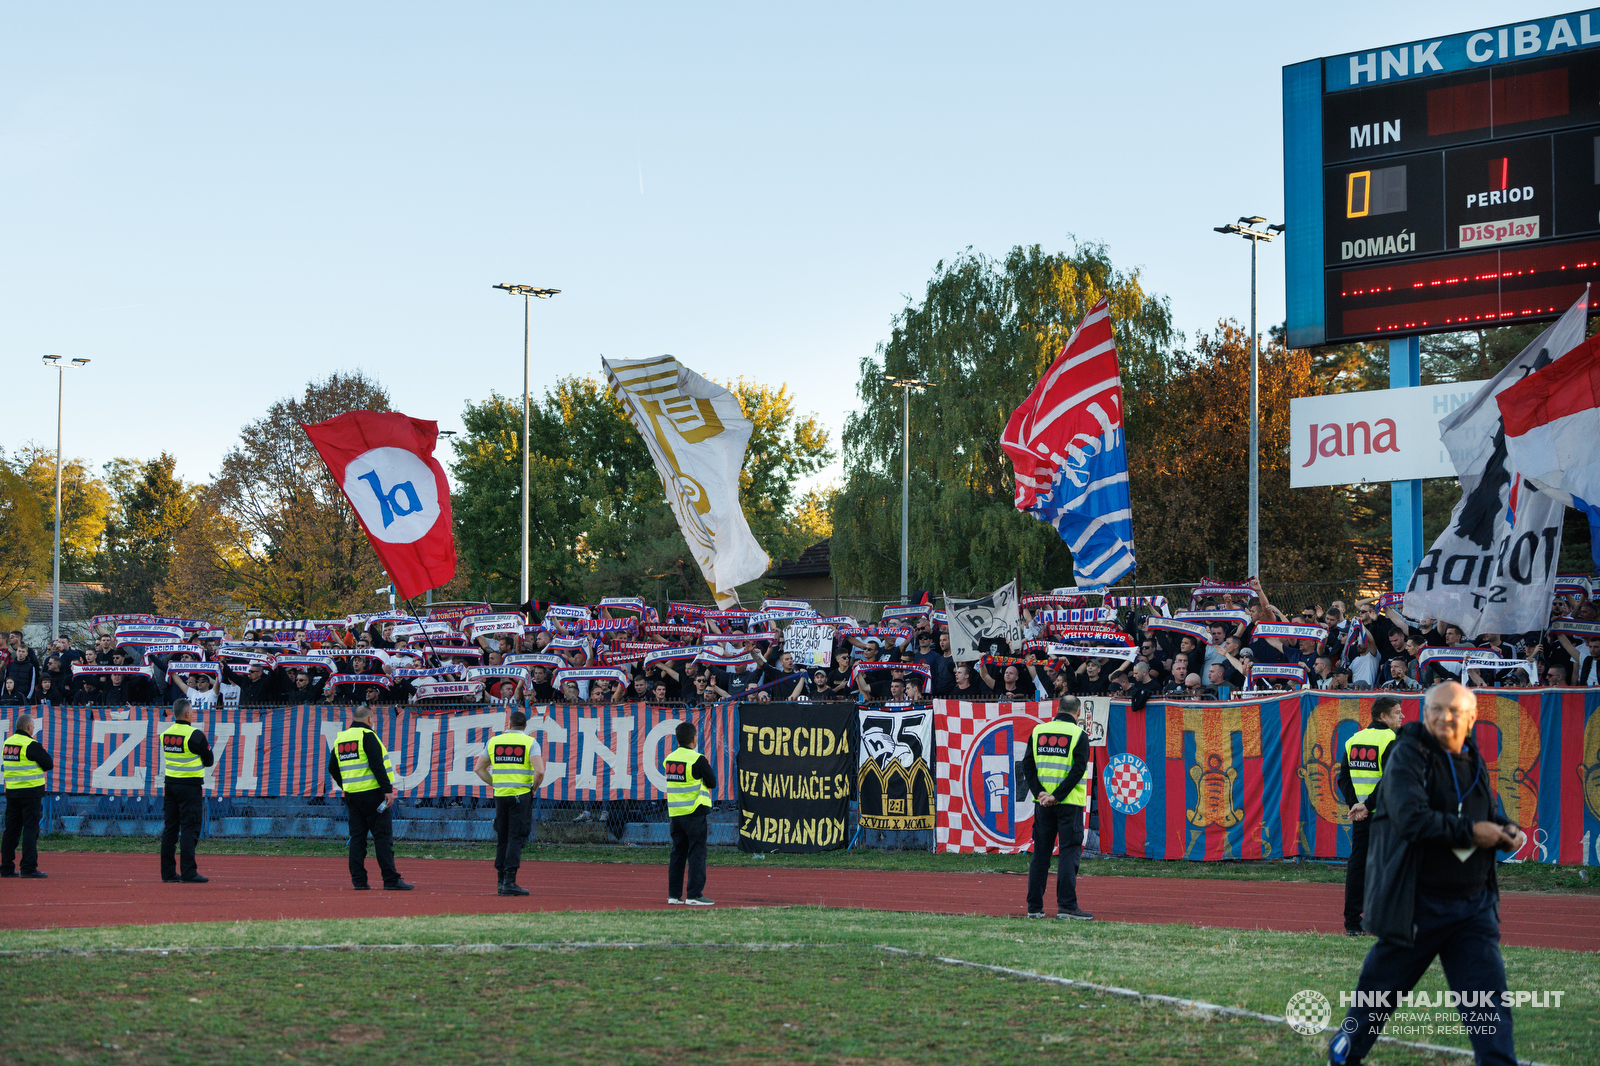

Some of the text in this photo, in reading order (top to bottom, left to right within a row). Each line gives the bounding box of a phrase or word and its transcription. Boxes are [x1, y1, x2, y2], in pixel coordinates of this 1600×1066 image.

[1350, 41, 1443, 84] HNK
[1350, 119, 1401, 149] MIN
[1347, 171, 1371, 218] 0
[1467, 186, 1535, 208] PERIOD
[1461, 221, 1538, 243] DiSplay
[1341, 229, 1416, 260] DOMAĆI
[551, 607, 585, 617] TORCIDA
[674, 606, 700, 614] TORCIDA
[908, 606, 927, 614] SPLIT
[436, 612, 463, 620] TORCIDA
[751, 611, 785, 622] WHITE
[794, 610, 818, 618] BOYS
[583, 618, 629, 631] HAJDUK
[1184, 623, 1200, 632] SPLIT
[1563, 623, 1594, 631] HAJDUK
[1261, 625, 1315, 636] HAJDUK SPLIT
[1063, 631, 1126, 642] WHITE BOYS
[1054, 646, 1131, 657] WHITE BOYS
[1437, 649, 1486, 658] HAJDUK SPLIT
[477, 666, 523, 676] TORCIDA
[1252, 666, 1300, 676] HAJDUK SPLIT
[433, 685, 470, 693] TORCIDA
[743, 724, 849, 757] TORCIDA
[1037, 746, 1067, 755] SECURITAS
[495, 755, 524, 763] SECURITAS
[739, 769, 850, 800] UZ NAVIJAČE SA
[889, 800, 905, 812] 2:1
[1109, 795, 1142, 813] SPLIT
